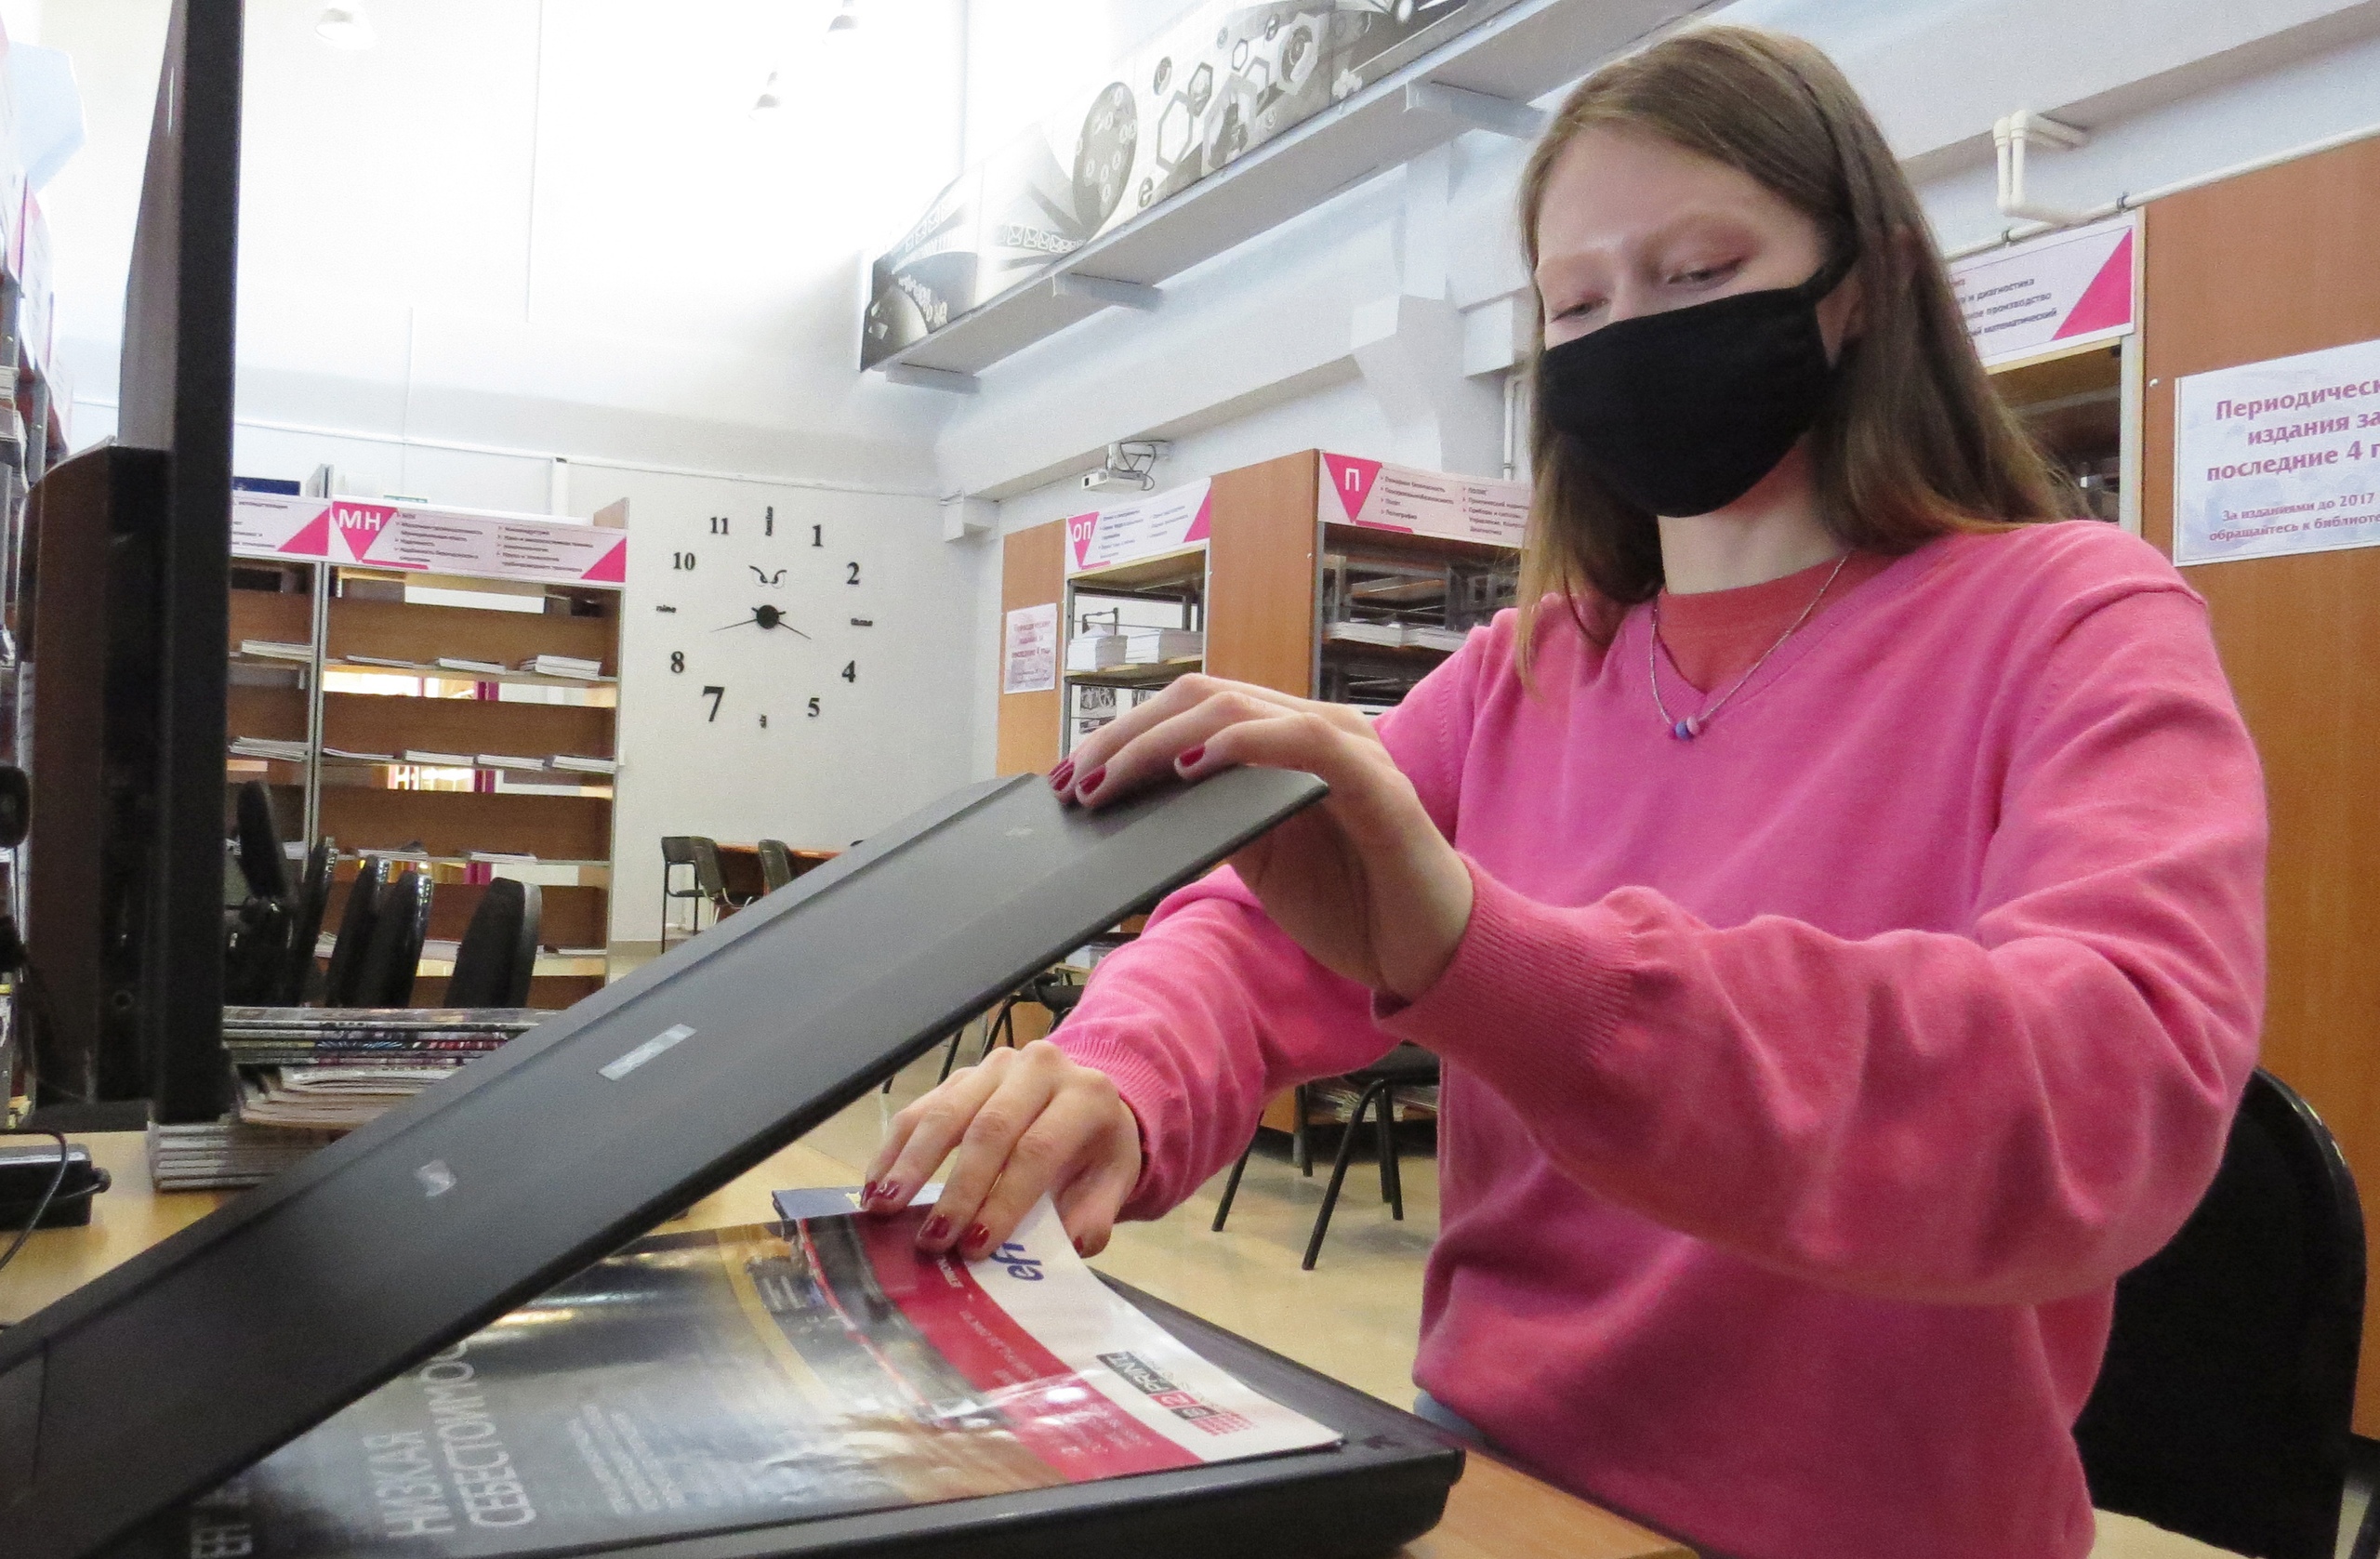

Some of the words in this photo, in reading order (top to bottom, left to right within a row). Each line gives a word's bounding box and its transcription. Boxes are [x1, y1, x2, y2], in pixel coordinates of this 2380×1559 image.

[1977, 278, 2034, 300] диагностика
[1987, 293, 2051, 315] производство
[2248, 416, 2349, 445] издания
[2207, 449, 2338, 481] последние
[2347, 440, 2362, 460] 4
[1345, 468, 1359, 492] П
[2241, 503, 2314, 520] изданиями
[2317, 500, 2335, 511] до
[2339, 492, 2375, 508] 2017
[710, 516, 729, 535] 11
[812, 524, 823, 548] 1
[1074, 521, 1091, 542] ОП
[2209, 523, 2298, 542] обращайтесь
[673, 552, 695, 571] 10
[846, 562, 860, 586] 2
[670, 651, 685, 674] 8
[841, 660, 856, 683] 4
[702, 685, 725, 722] 7
[807, 697, 821, 718] 5
[363, 1430, 456, 1538] НИЗКАЯ
